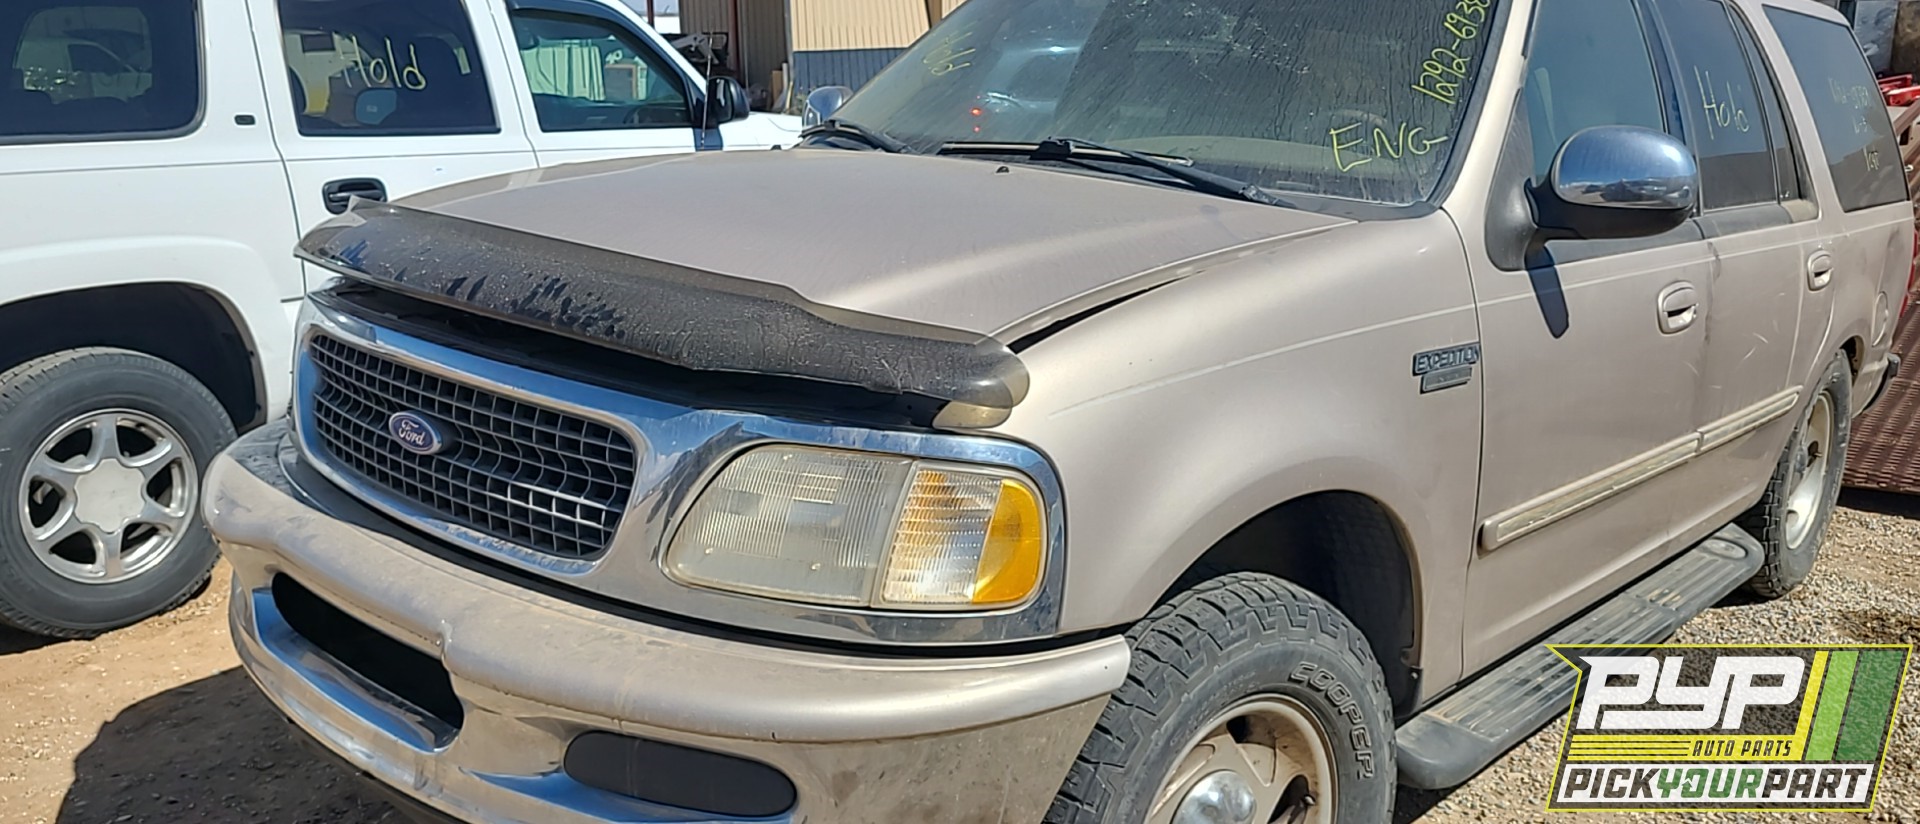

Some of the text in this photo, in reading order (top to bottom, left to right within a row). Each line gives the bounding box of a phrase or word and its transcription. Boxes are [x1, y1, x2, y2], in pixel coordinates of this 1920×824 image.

[332, 32, 427, 90] Hold
[1328, 121, 1449, 172] ENG
[1415, 345, 1480, 373] EXPEDITION
[398, 419, 426, 446] Ford
[1288, 661, 1375, 780] COOPER
